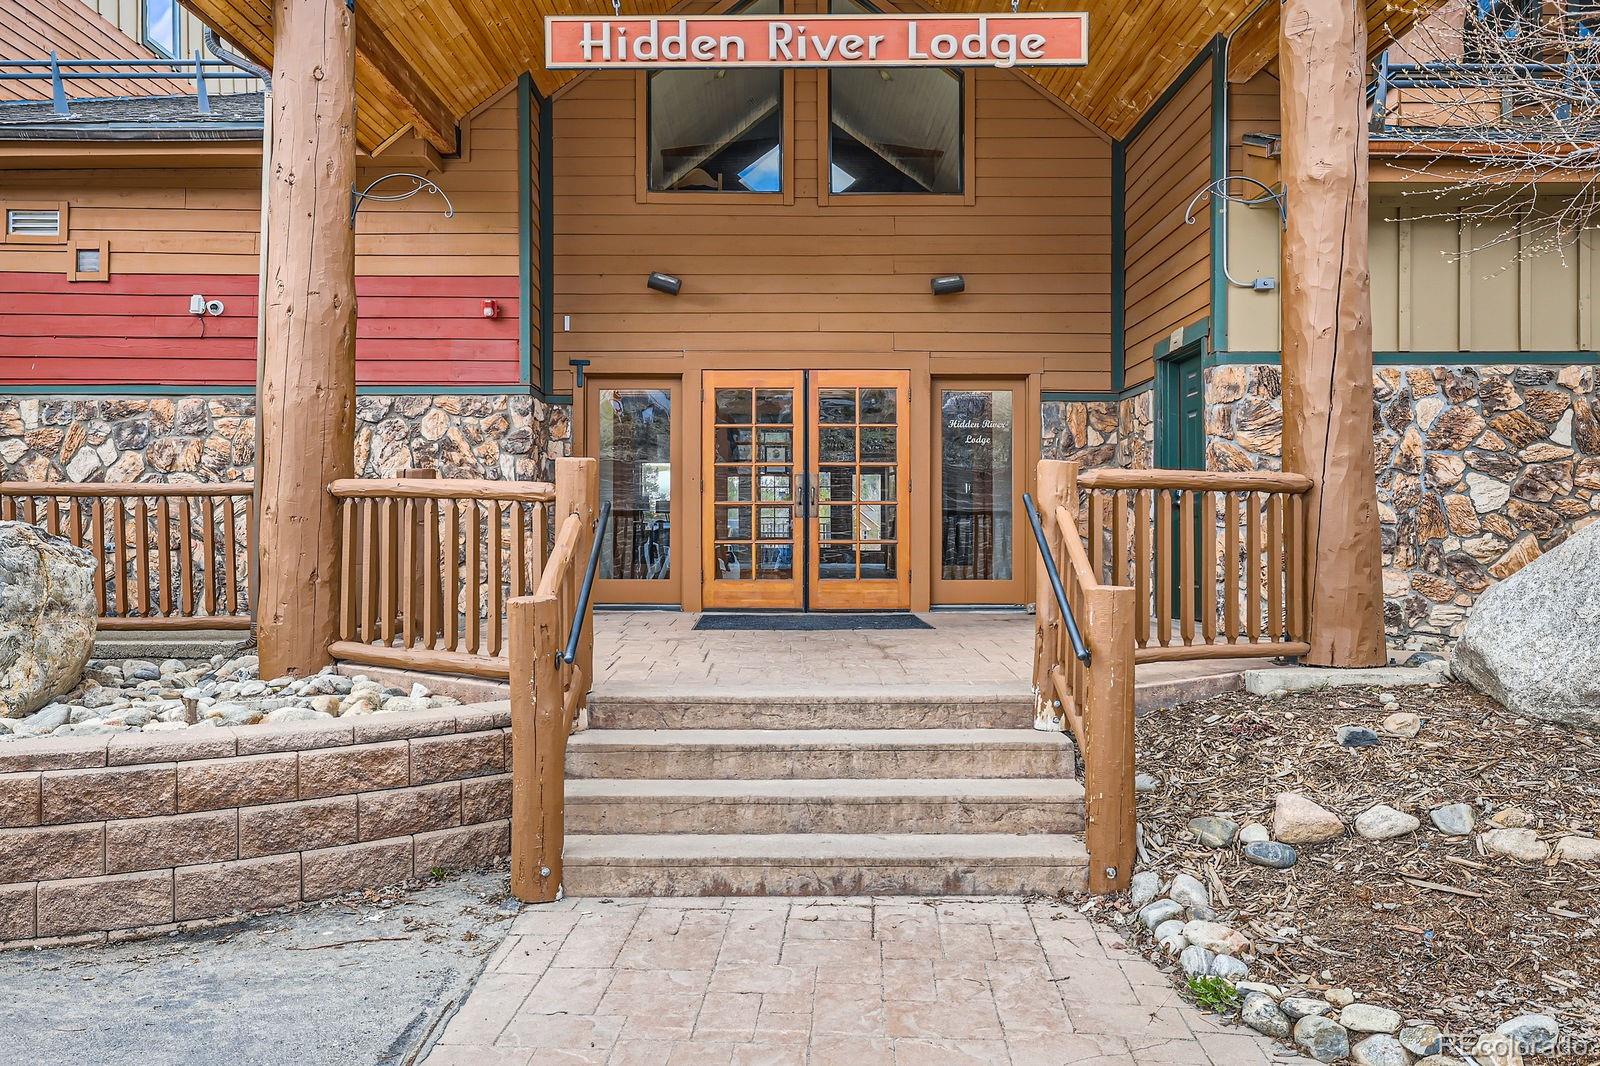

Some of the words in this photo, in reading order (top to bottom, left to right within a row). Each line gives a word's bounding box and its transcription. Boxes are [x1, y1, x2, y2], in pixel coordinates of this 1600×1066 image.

[580, 19, 745, 61] Hidden
[767, 22, 884, 60] River
[908, 18, 1046, 68] Lodge
[948, 420, 980, 428] Hidden
[965, 435, 990, 446] Lodge
